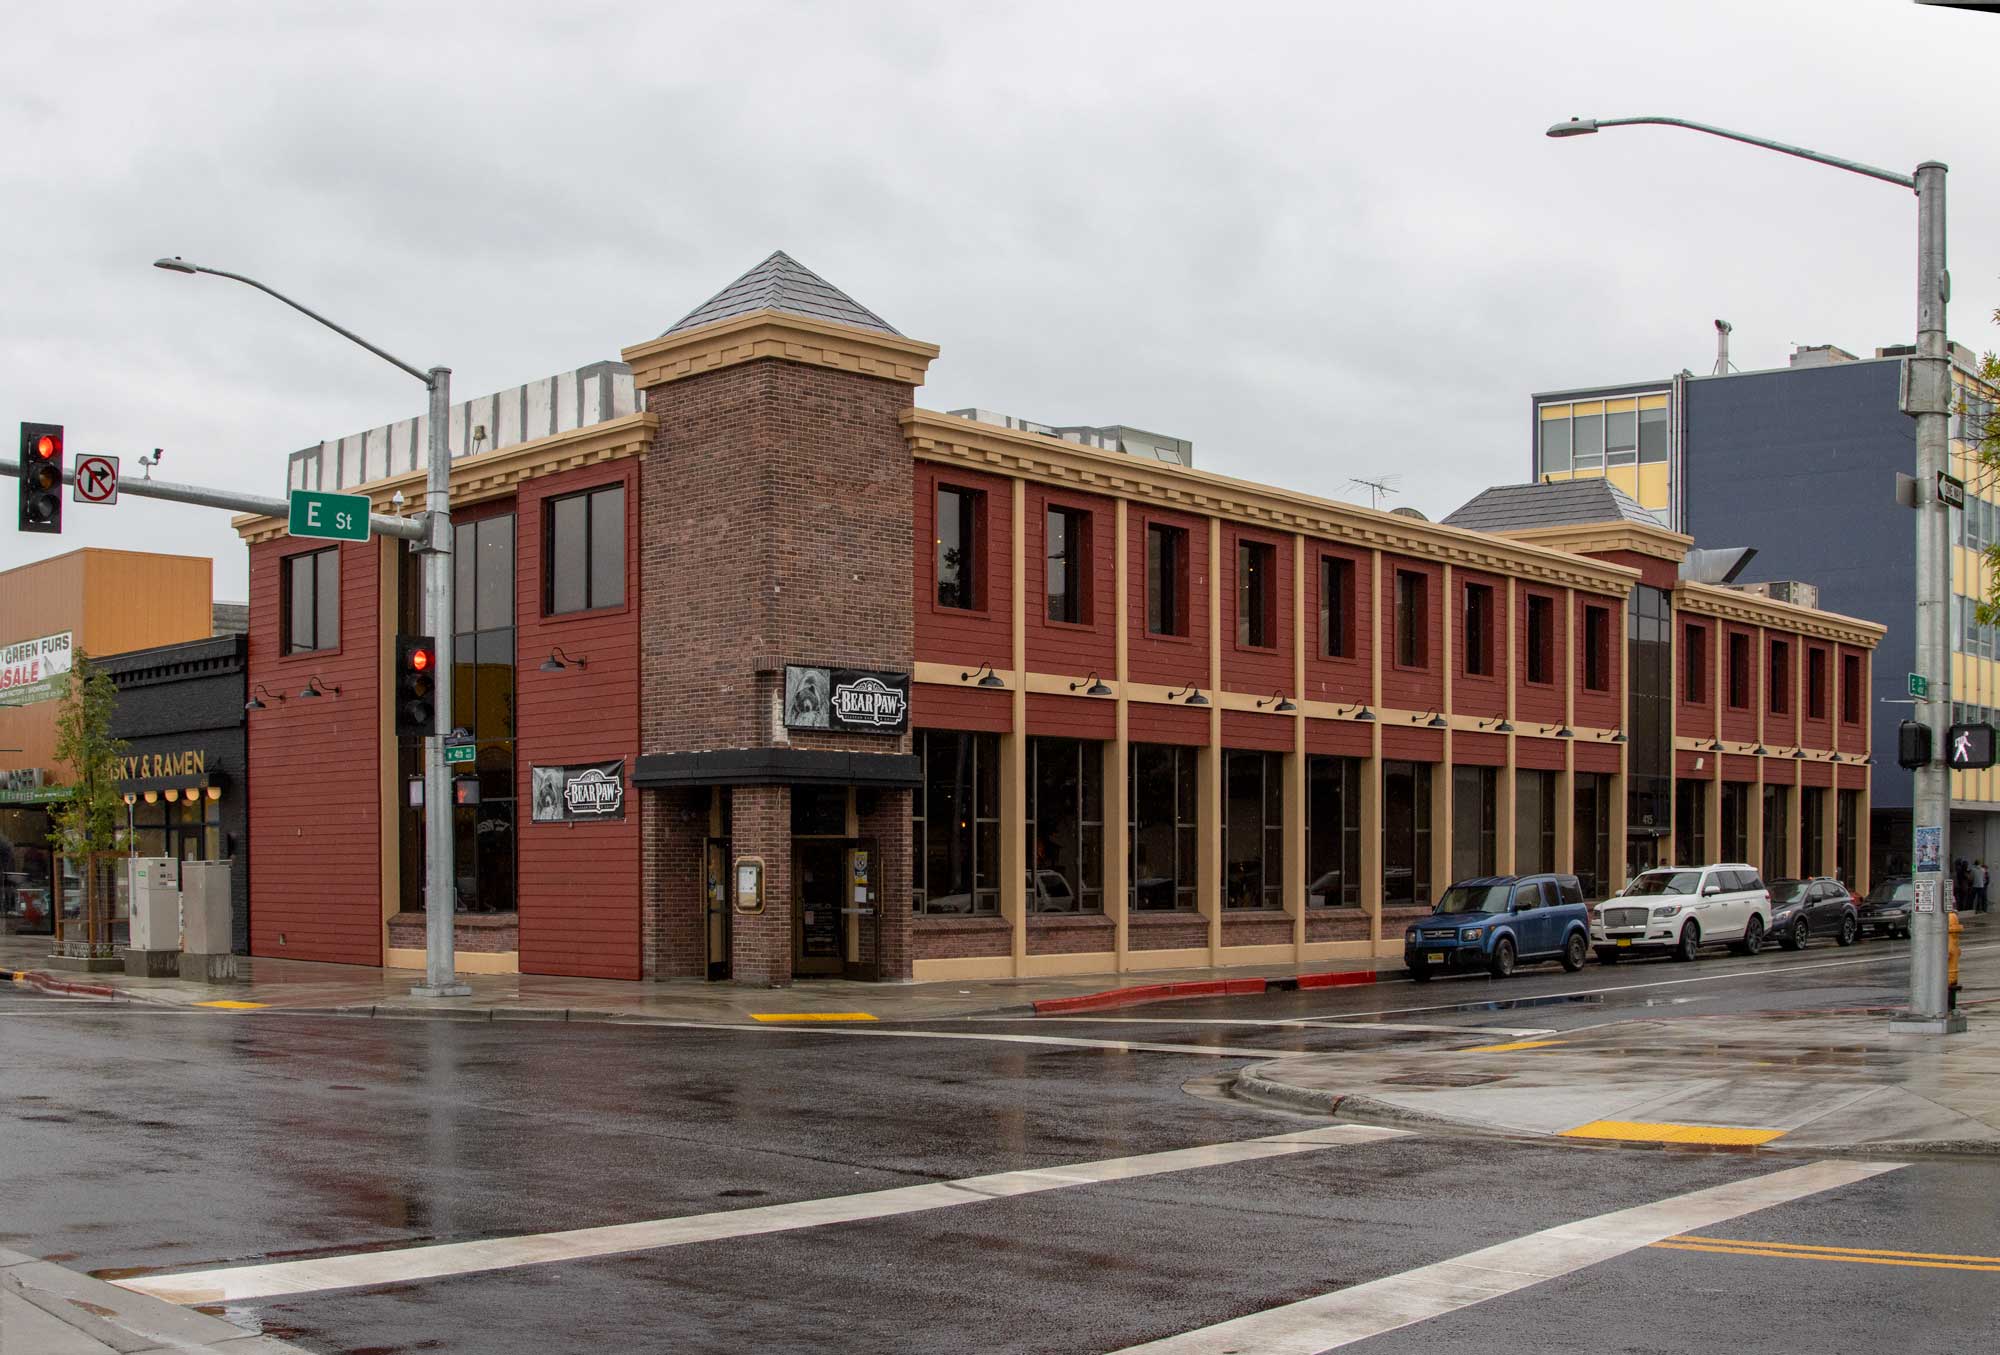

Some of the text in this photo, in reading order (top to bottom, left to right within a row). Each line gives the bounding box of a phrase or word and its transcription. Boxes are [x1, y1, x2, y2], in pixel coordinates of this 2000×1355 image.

[307, 501, 352, 530] E St
[5, 642, 39, 664] GREEN
[41, 635, 70, 655] FURS
[3, 661, 40, 688] SALE
[841, 691, 898, 721] BEAR PAW
[141, 753, 151, 779] &
[153, 749, 204, 777] RAMEN
[571, 782, 616, 810] BEAR PAW
